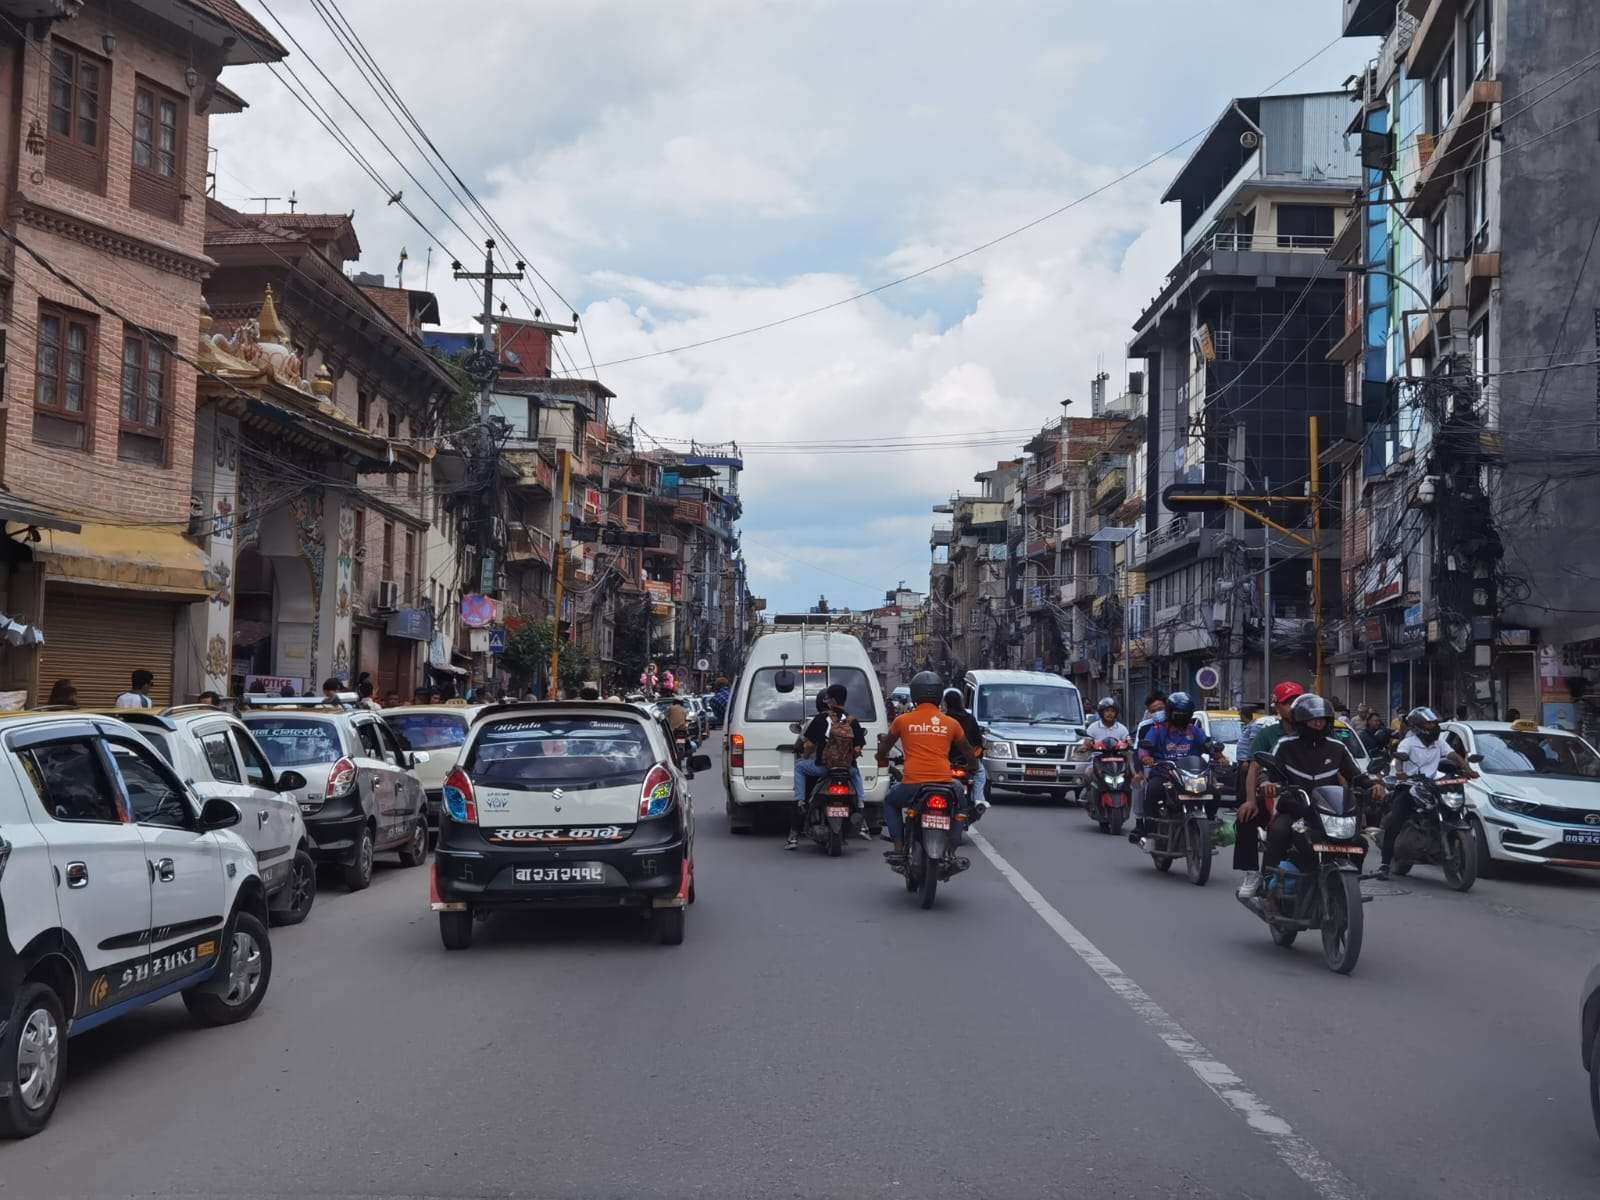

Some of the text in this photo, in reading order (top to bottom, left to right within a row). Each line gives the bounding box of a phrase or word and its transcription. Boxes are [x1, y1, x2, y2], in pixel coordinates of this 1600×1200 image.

[255, 677, 293, 689] NOTICE
[908, 722, 948, 734] miraz
[494, 827, 562, 841] सुन्दर
[119, 946, 197, 988] SUZUKI
